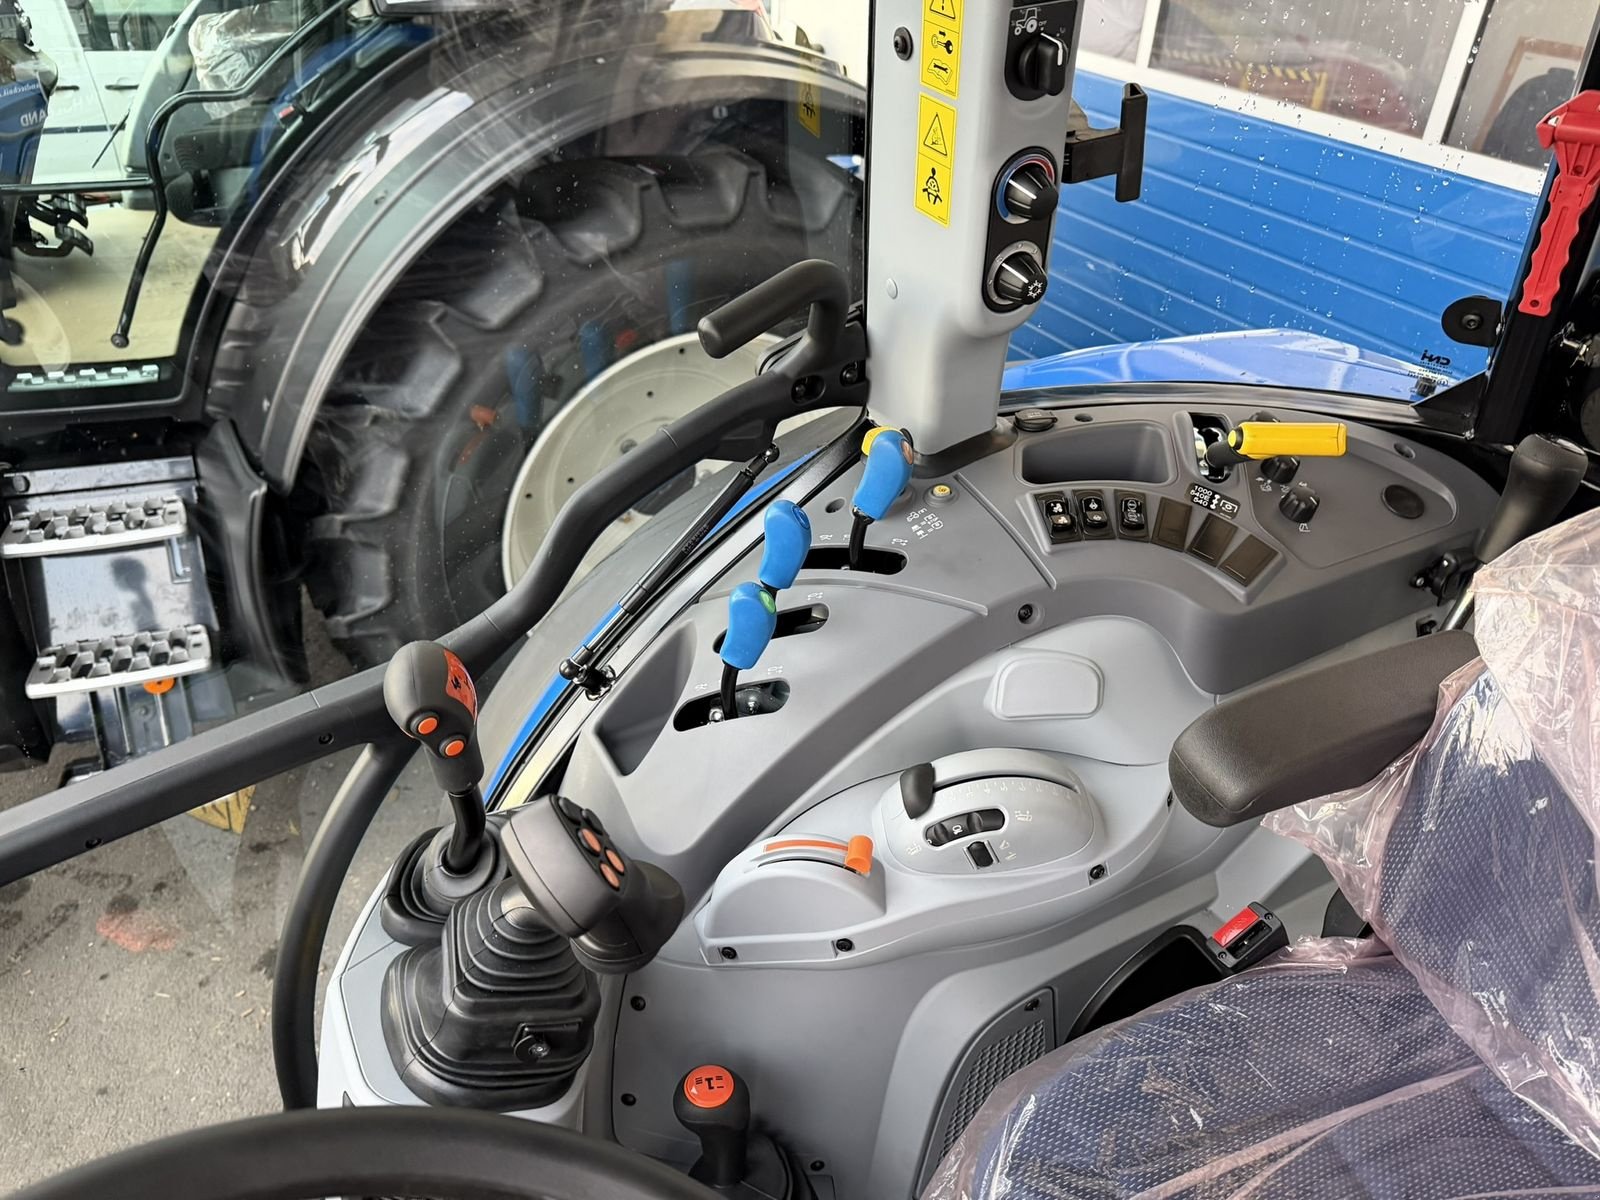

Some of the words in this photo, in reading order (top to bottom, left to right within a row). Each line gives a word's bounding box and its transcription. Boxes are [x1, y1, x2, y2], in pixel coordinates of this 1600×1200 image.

[1190, 489, 1210, 501] 540E
[1194, 485, 1213, 496] 1000
[1193, 497, 1208, 506] 540
